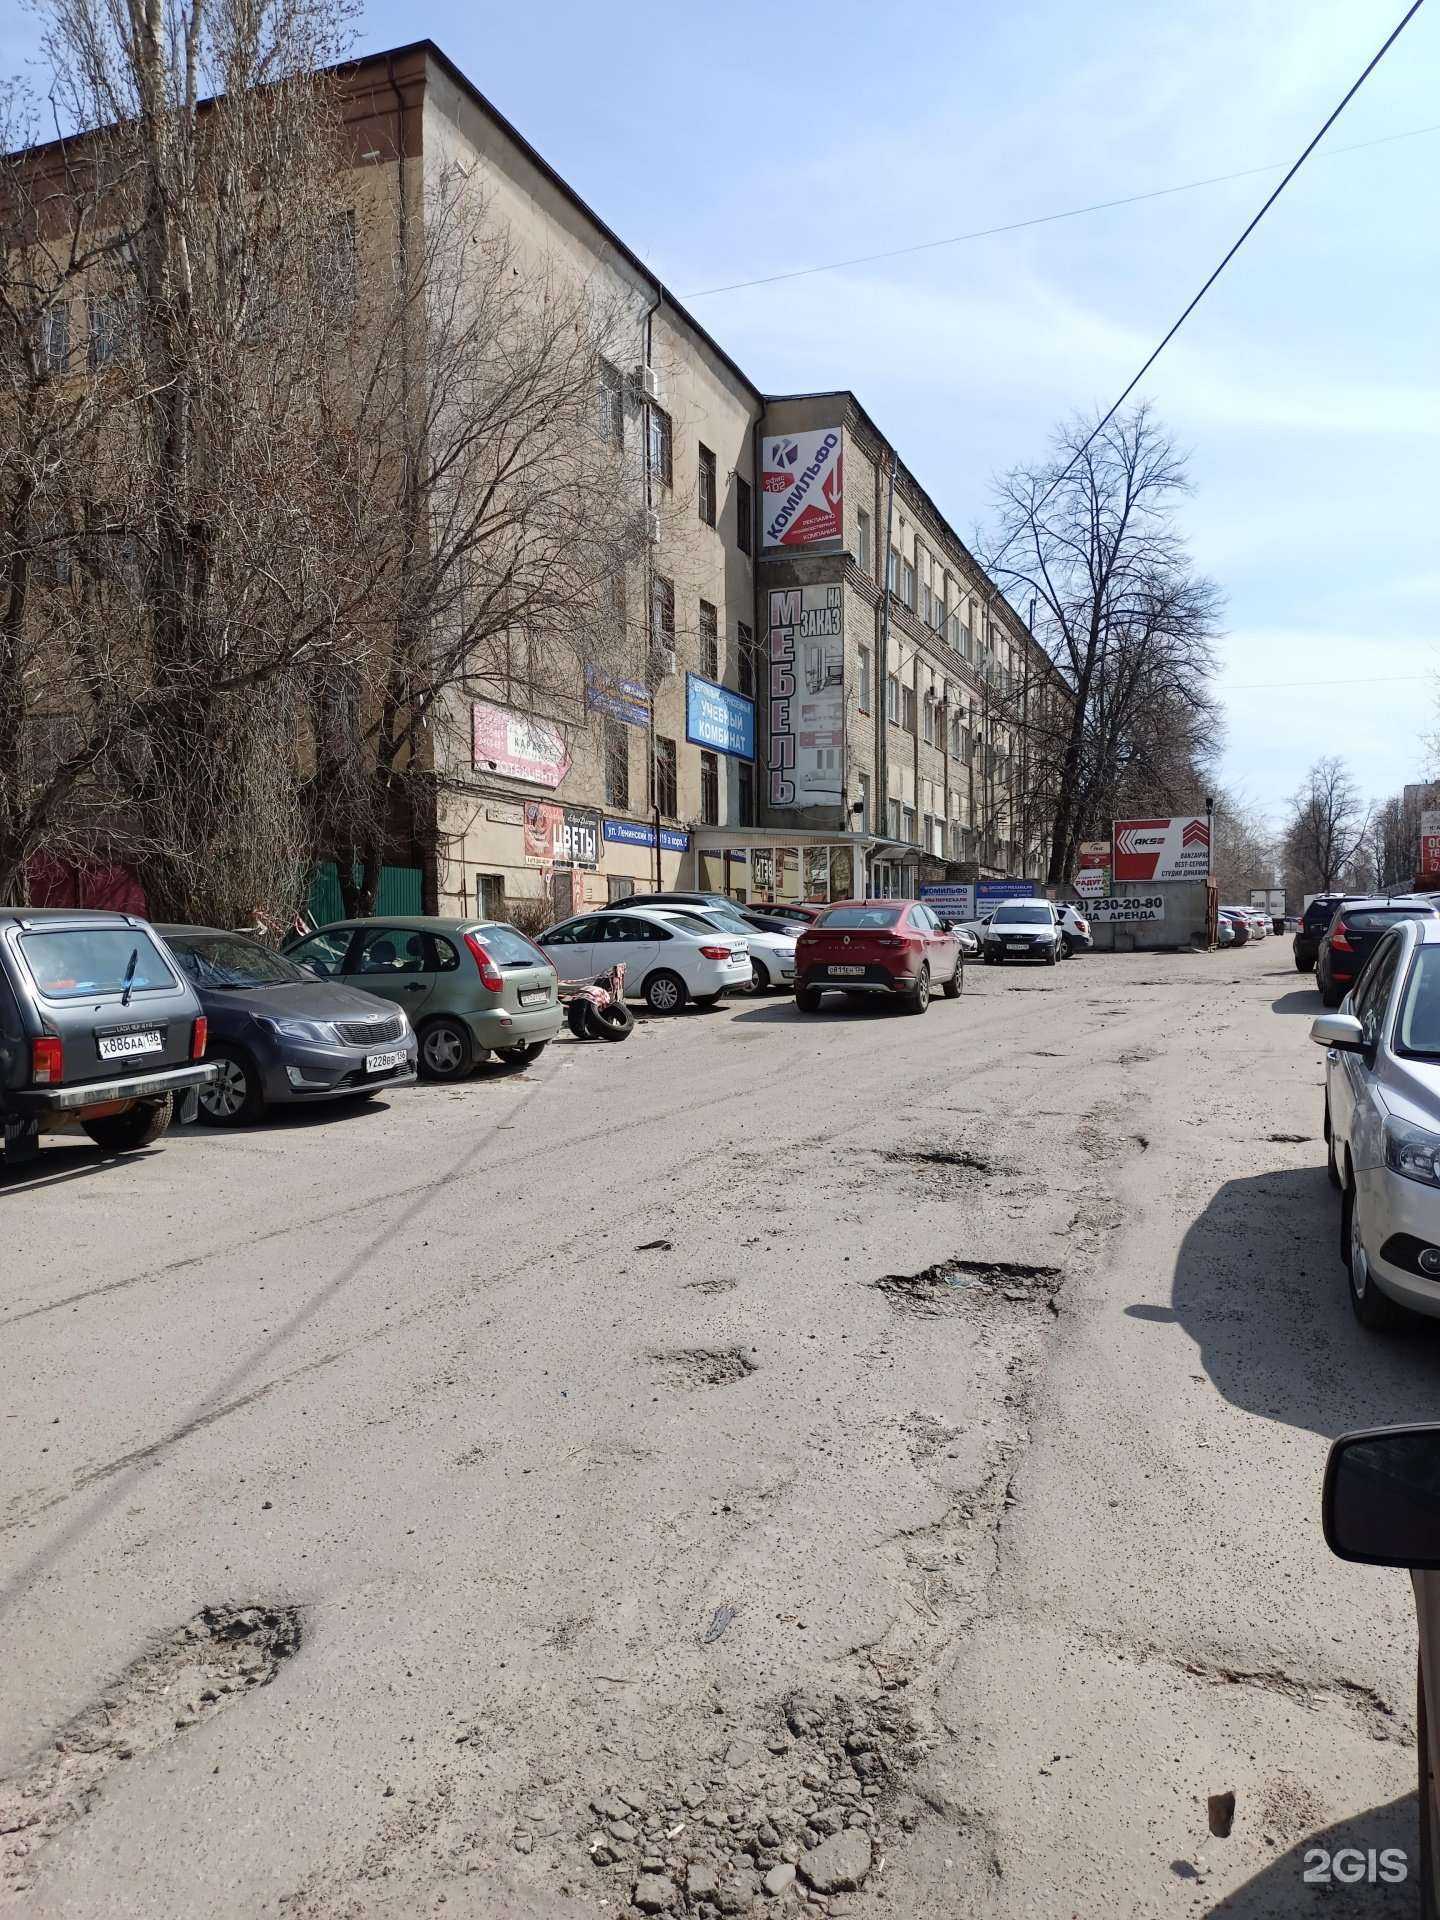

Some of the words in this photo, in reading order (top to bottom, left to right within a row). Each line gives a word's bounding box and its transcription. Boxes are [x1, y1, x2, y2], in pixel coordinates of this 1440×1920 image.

[767, 433, 838, 540] КОМИЛЬФО
[827, 587, 841, 608] НА
[800, 607, 841, 638] ЗАКАЗ
[768, 589, 803, 805] МЕБЕЛЬ
[701, 700, 743, 731] УЧЕБНЫЙ
[700, 720, 746, 751] КОМБИНАТ
[553, 823, 596, 860] ЦВЕТЫ
[607, 826, 617, 838] ул.
[618, 825, 647, 841] Ленинский
[1093, 897, 1163, 911] 230-20-80
[1109, 910, 1156, 921] АРЕНДА
